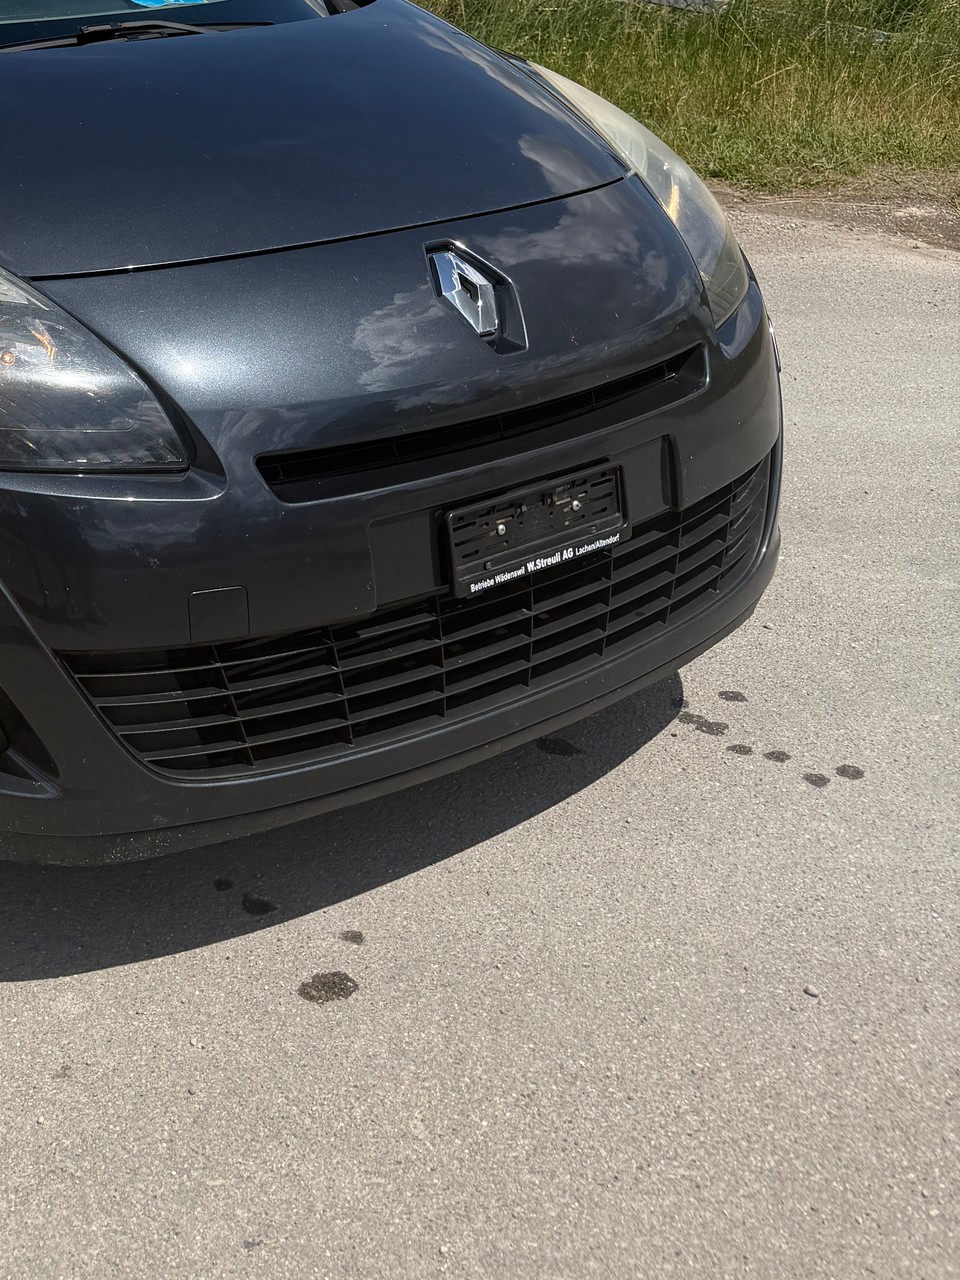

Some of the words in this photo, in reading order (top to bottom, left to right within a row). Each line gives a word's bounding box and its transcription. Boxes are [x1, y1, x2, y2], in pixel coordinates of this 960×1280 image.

[470, 578, 495, 593] Betriebe
[494, 566, 525, 584] Wädenswil
[527, 552, 561, 572] W.Streuli
[562, 547, 574, 561] AG
